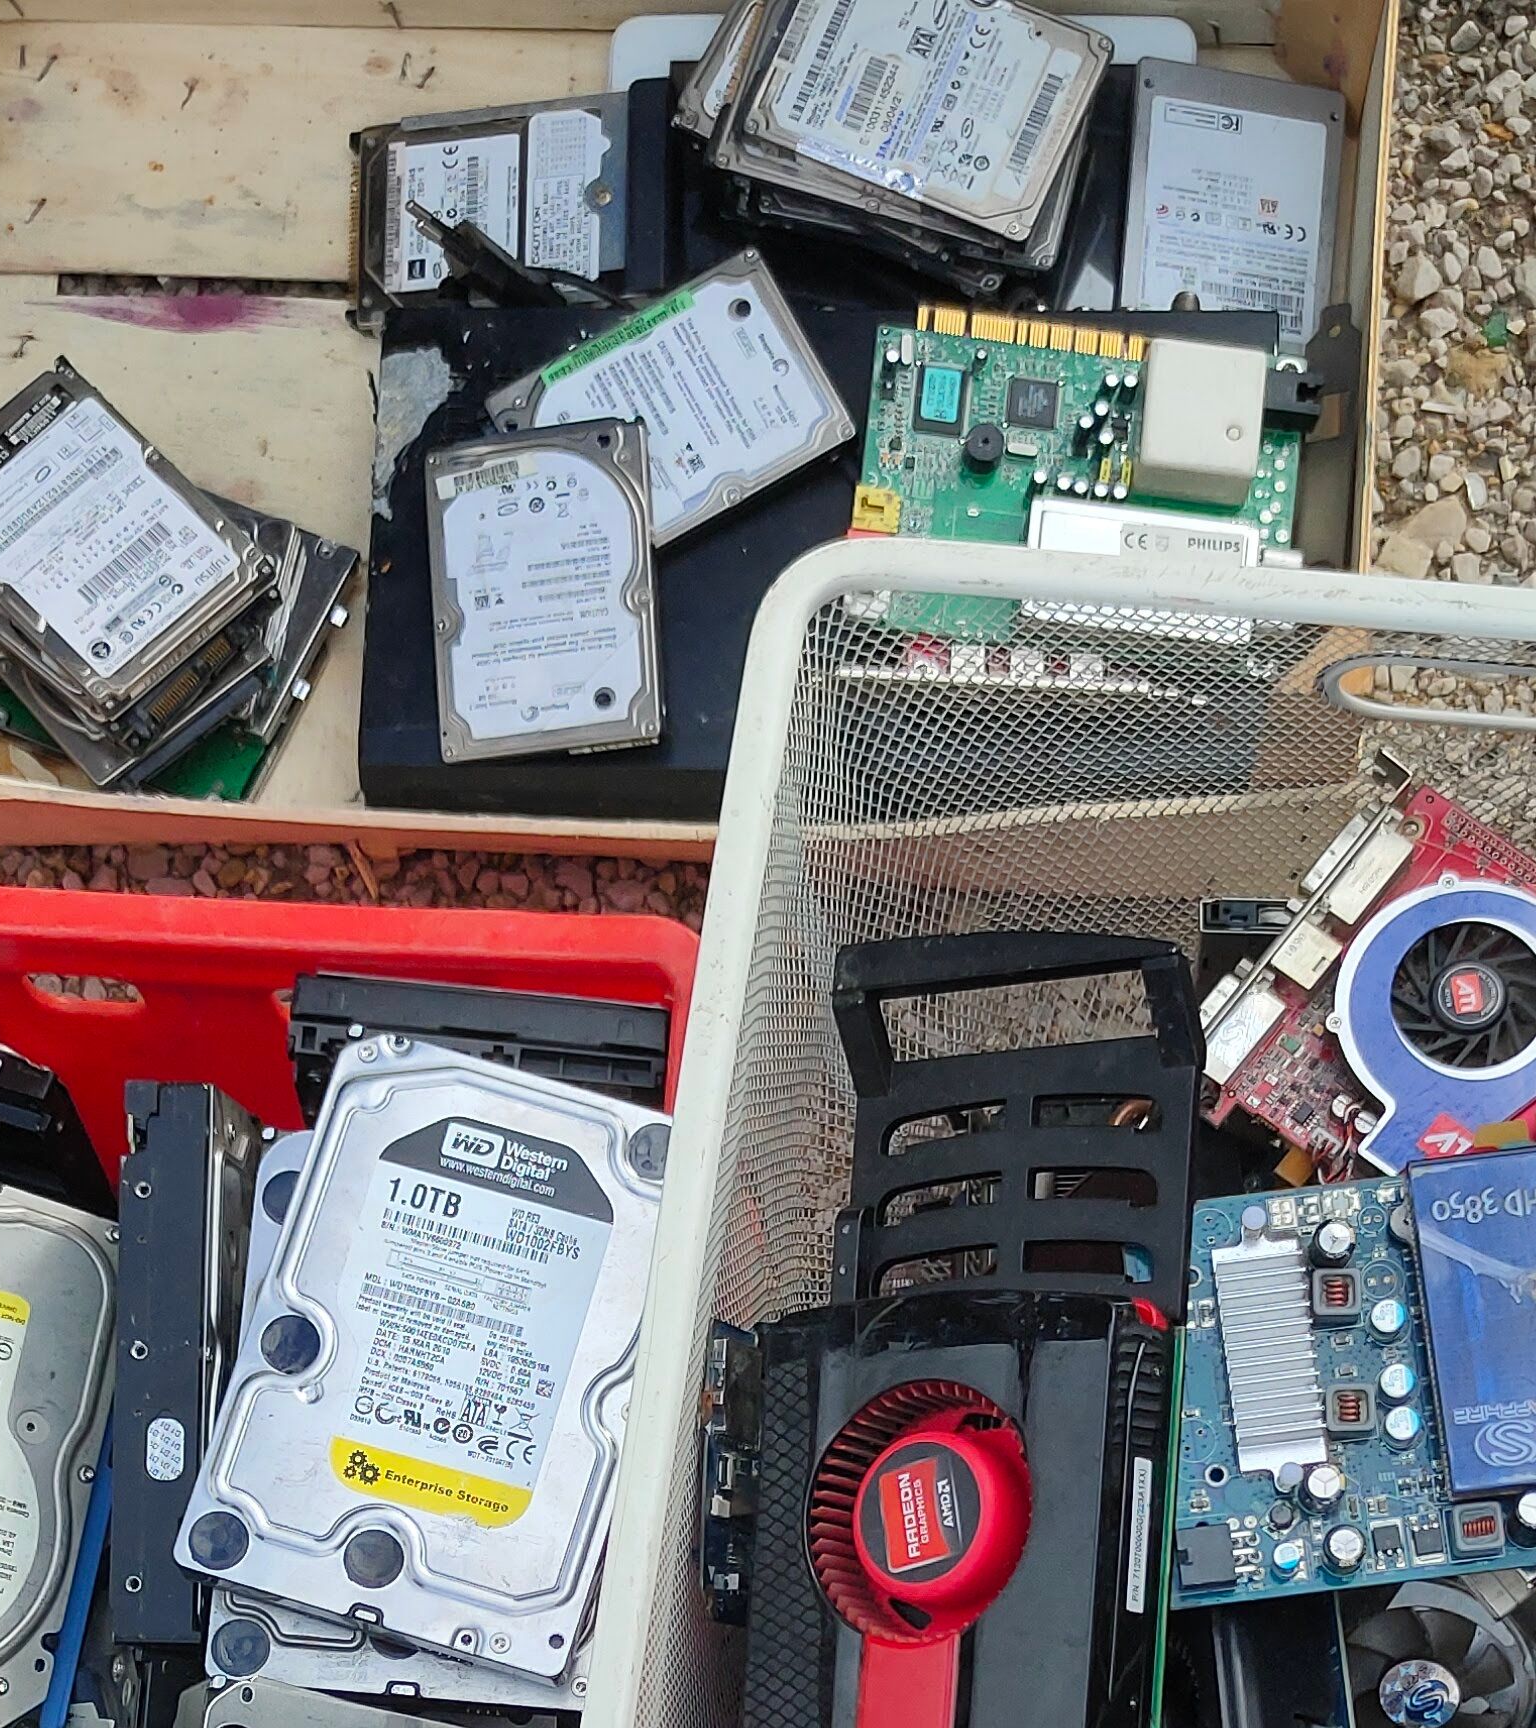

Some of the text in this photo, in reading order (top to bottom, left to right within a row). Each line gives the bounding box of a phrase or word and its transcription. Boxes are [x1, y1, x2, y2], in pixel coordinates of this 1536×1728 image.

[910, 27, 938, 59] ATA
[967, 23, 992, 51] CE
[442, 145, 458, 169] CE
[532, 206, 540, 265] CAUTION
[1283, 223, 1306, 242] CE
[755, 332, 777, 362] Seagate
[1123, 531, 1149, 550] CE
[1186, 537, 1241, 553] PHILIPS
[192, 552, 230, 586] FUJITSU
[1454, 975, 1475, 1013] ATI
[451, 1131, 495, 1158] WD
[504, 1141, 568, 1171] Western
[438, 1156, 554, 1197] www.westerndigital.com
[500, 1153, 552, 1181] Digital
[386, 1176, 462, 1218] 1.0TB
[1429, 1186, 1499, 1226] 3850
[507, 1218, 528, 1232] SATA
[510, 1207, 541, 1224] WD RE3
[504, 1228, 581, 1260] WD1002FBYS
[460, 1399, 489, 1426] ATA
[505, 1439, 534, 1464] CE
[383, 1469, 509, 1514] Enterprise Storage
[898, 1470, 921, 1558] RADEON
[913, 1478, 929, 1544] GRAPHICS
[938, 1492, 954, 1527] AMD
[1131, 1584, 1139, 1602] P/N
